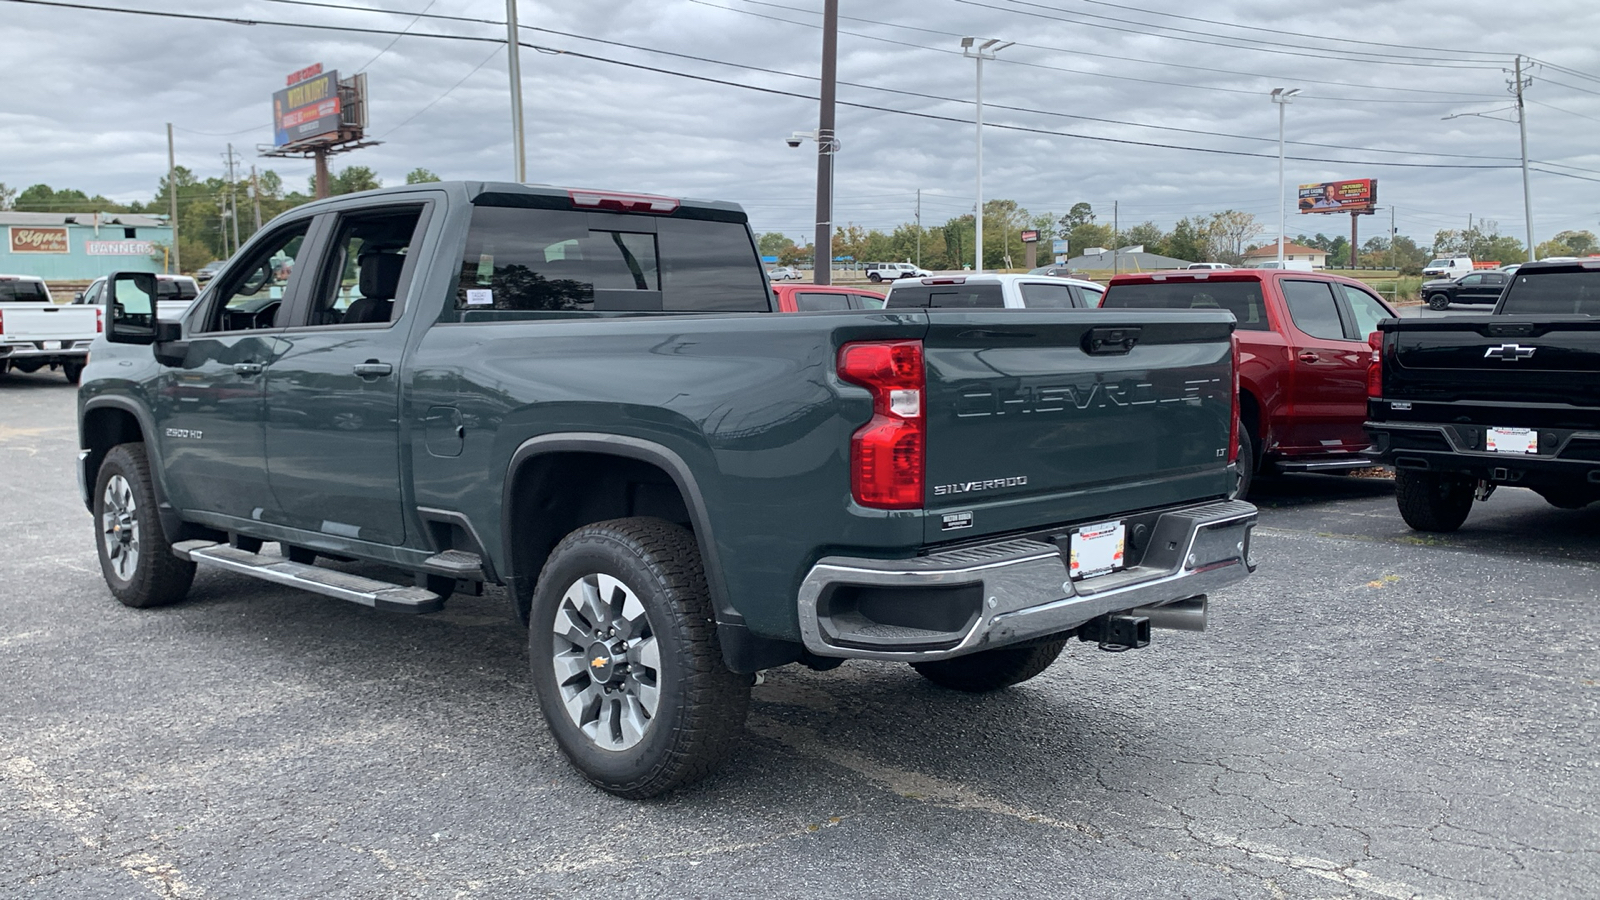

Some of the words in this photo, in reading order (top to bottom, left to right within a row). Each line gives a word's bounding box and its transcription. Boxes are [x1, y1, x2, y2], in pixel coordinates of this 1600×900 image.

[14, 229, 63, 247] Signs
[89, 242, 152, 255] BANNERS
[956, 377, 1221, 418] CHEVROLET
[166, 427, 189, 438] 2500
[189, 429, 203, 439] HD
[1216, 447, 1227, 457] LT
[933, 475, 1028, 496] SILVERADO
